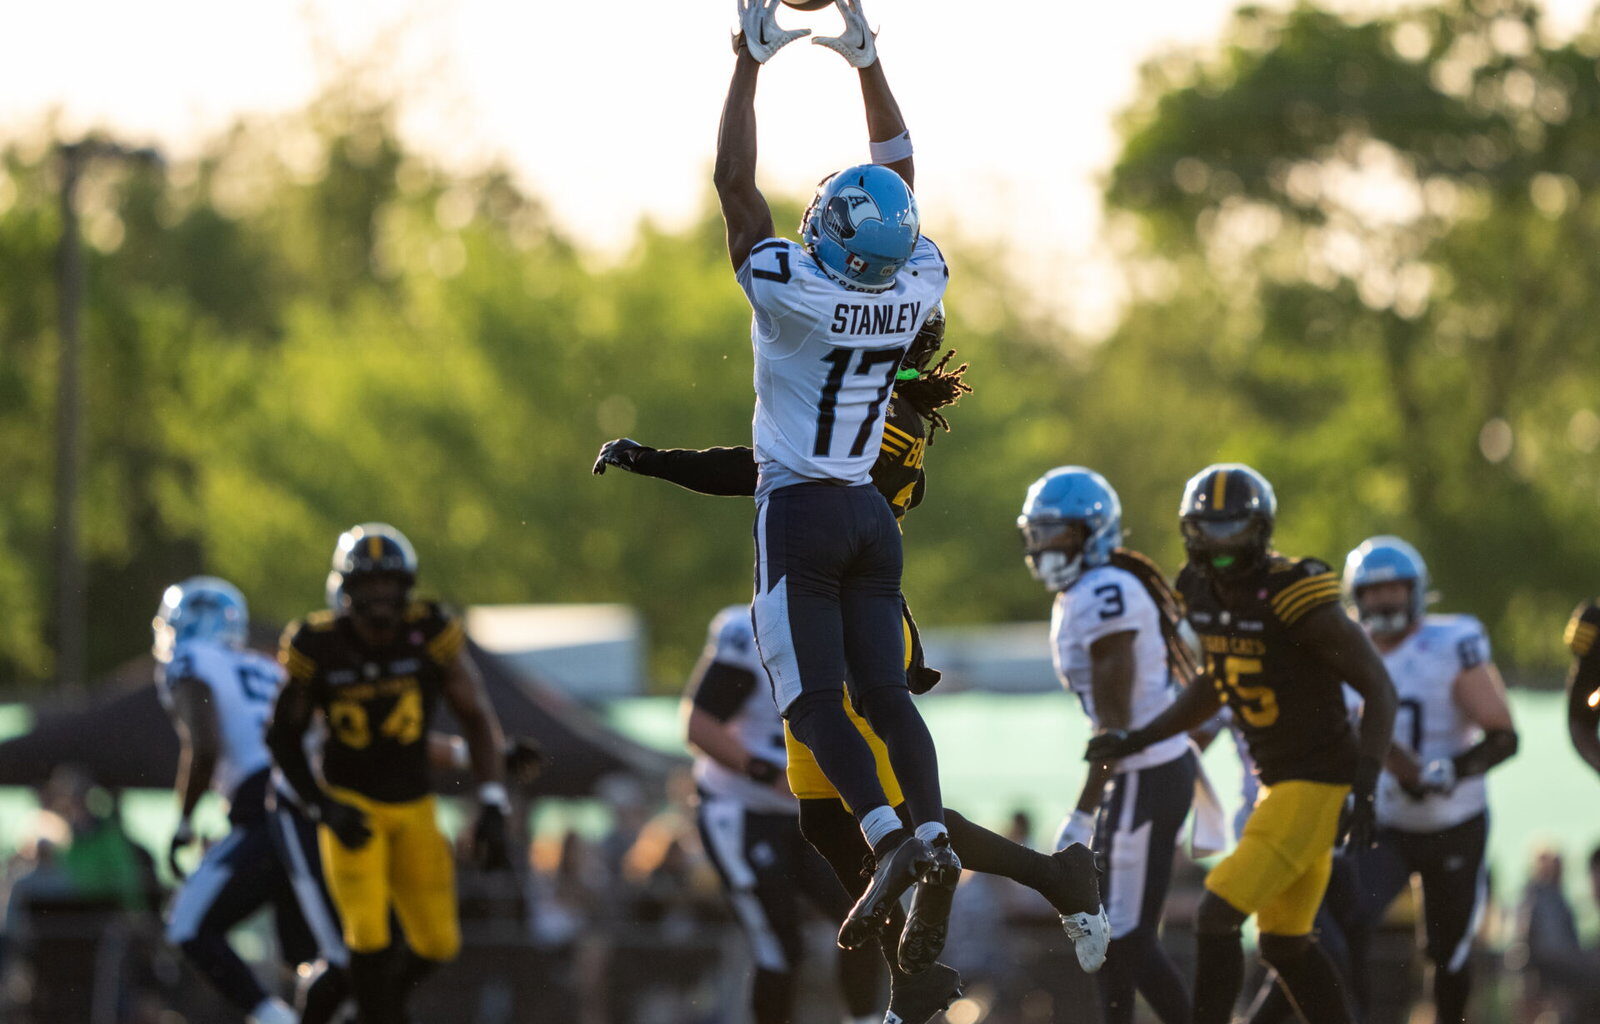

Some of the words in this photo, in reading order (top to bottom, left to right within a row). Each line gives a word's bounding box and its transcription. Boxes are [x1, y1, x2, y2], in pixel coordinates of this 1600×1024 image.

[751, 241, 792, 284] 17
[831, 302, 921, 336] STANLEY
[813, 347, 906, 458] 17
[1094, 584, 1125, 620] 3
